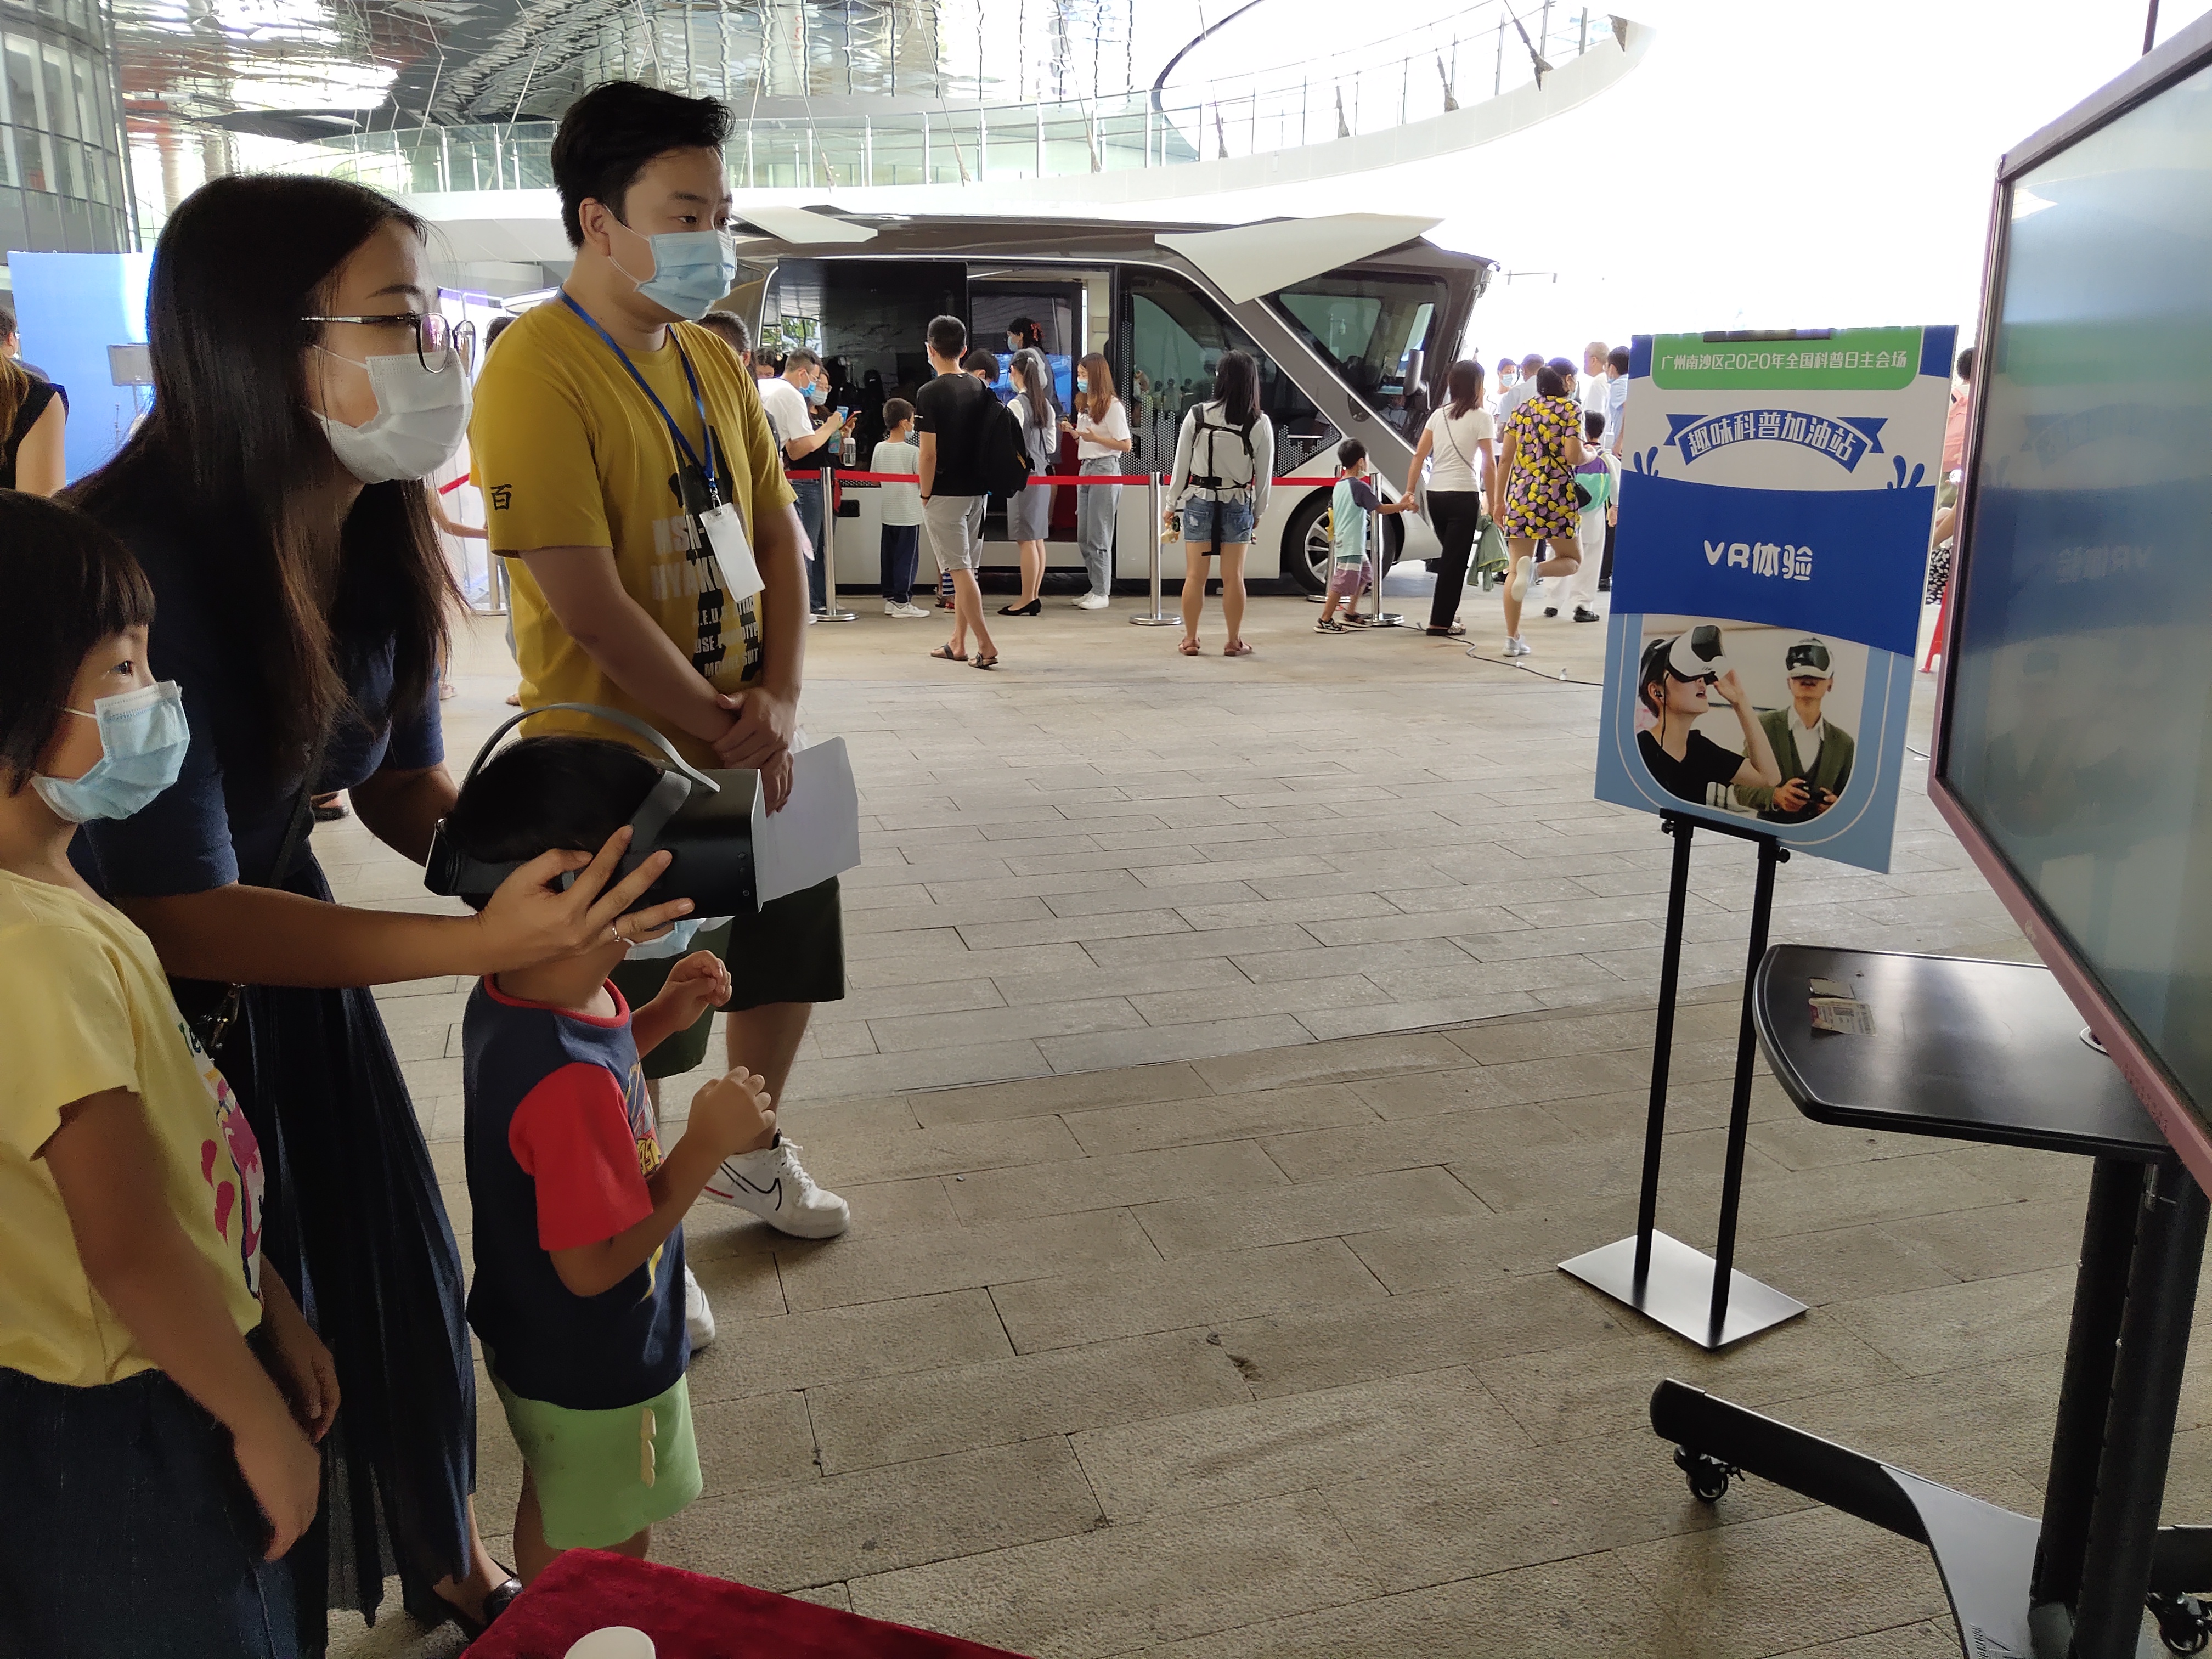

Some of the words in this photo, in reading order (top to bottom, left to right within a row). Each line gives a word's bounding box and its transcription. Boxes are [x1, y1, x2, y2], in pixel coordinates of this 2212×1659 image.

[1661, 351, 1907, 370] 广州南沙区2020年全国科普日主会场
[1687, 411, 1856, 461] 趣味科普加油站
[490, 484, 512, 510] 百
[1703, 540, 1813, 581] VR体验
